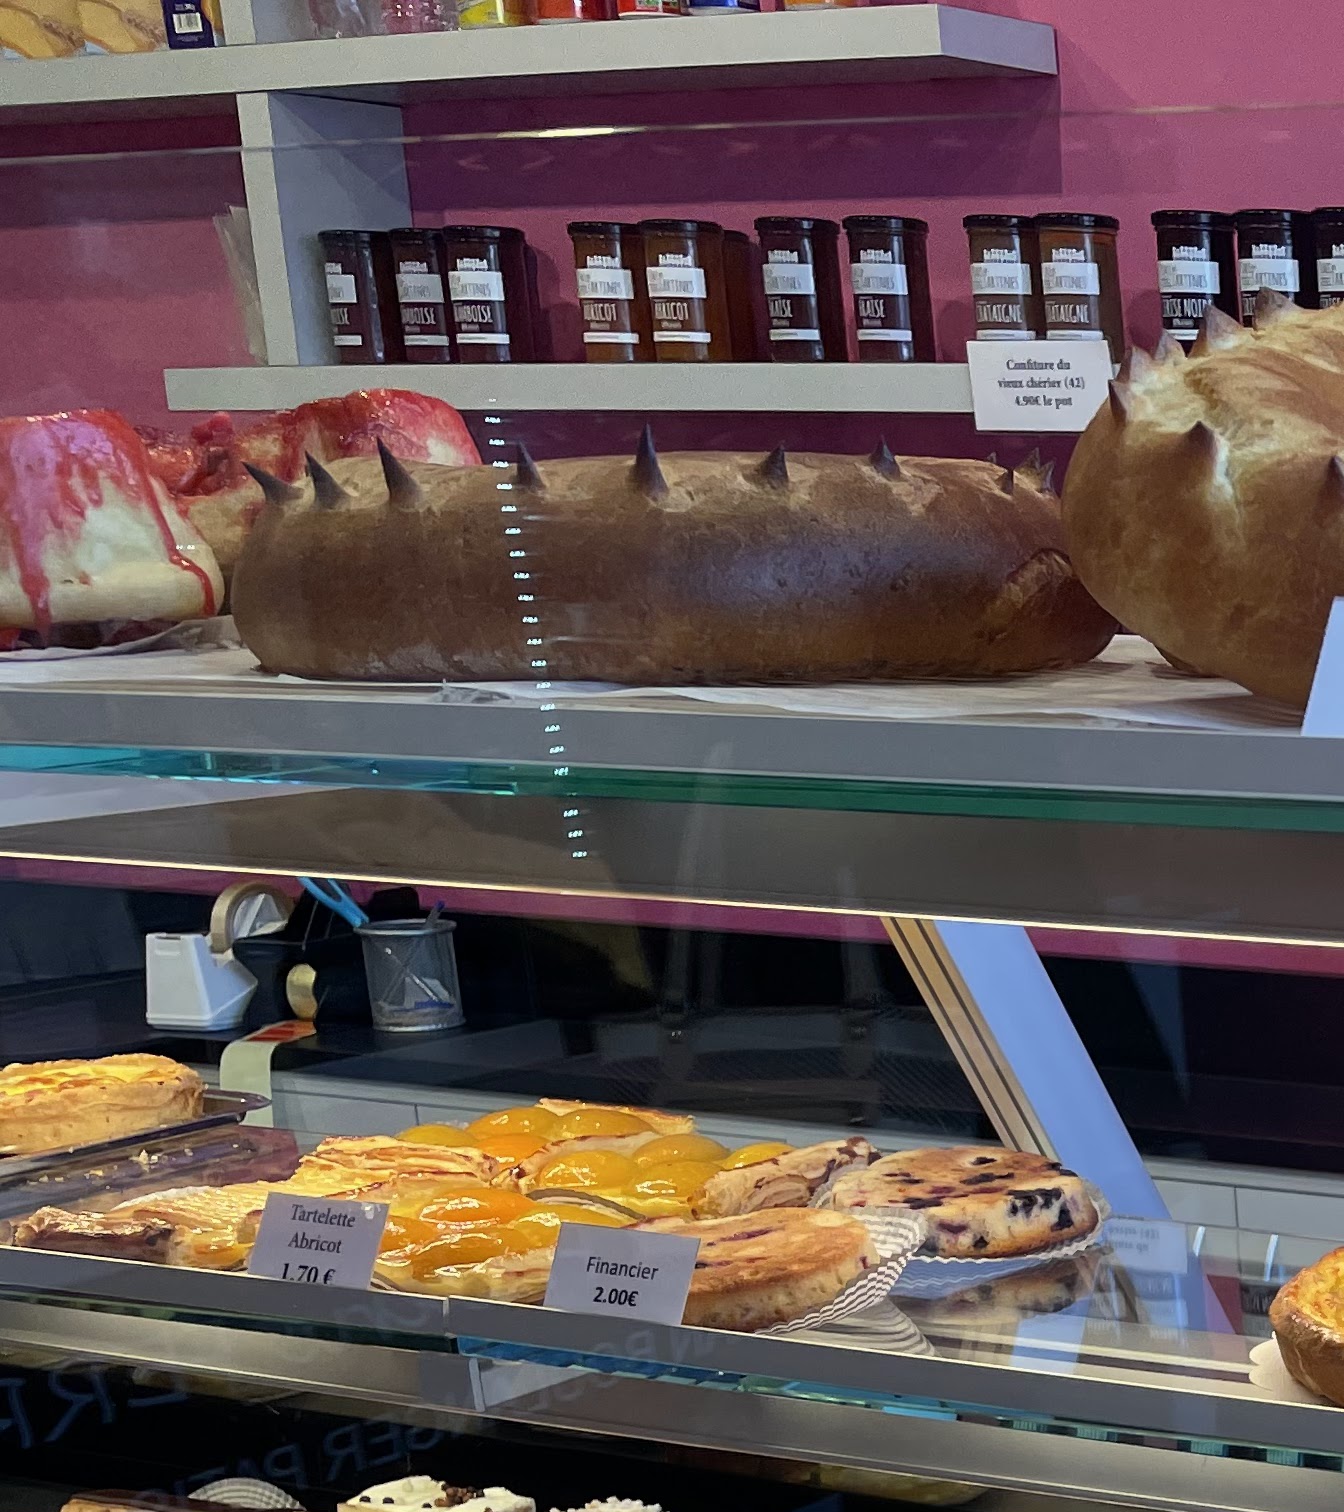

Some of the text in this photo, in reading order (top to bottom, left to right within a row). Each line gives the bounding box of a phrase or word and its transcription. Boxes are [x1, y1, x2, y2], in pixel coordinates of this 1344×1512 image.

[1006, 359, 1070, 370] Confiture du
[1064, 376, 1085, 390] (42)
[1043, 395, 1052, 406] le
[1055, 397, 1072, 409] pot
[290, 1203, 355, 1229] Tartelette
[287, 1231, 342, 1254] Abricot
[586, 1256, 658, 1281] Financier
[593, 1286, 639, 1307] 2.00€
